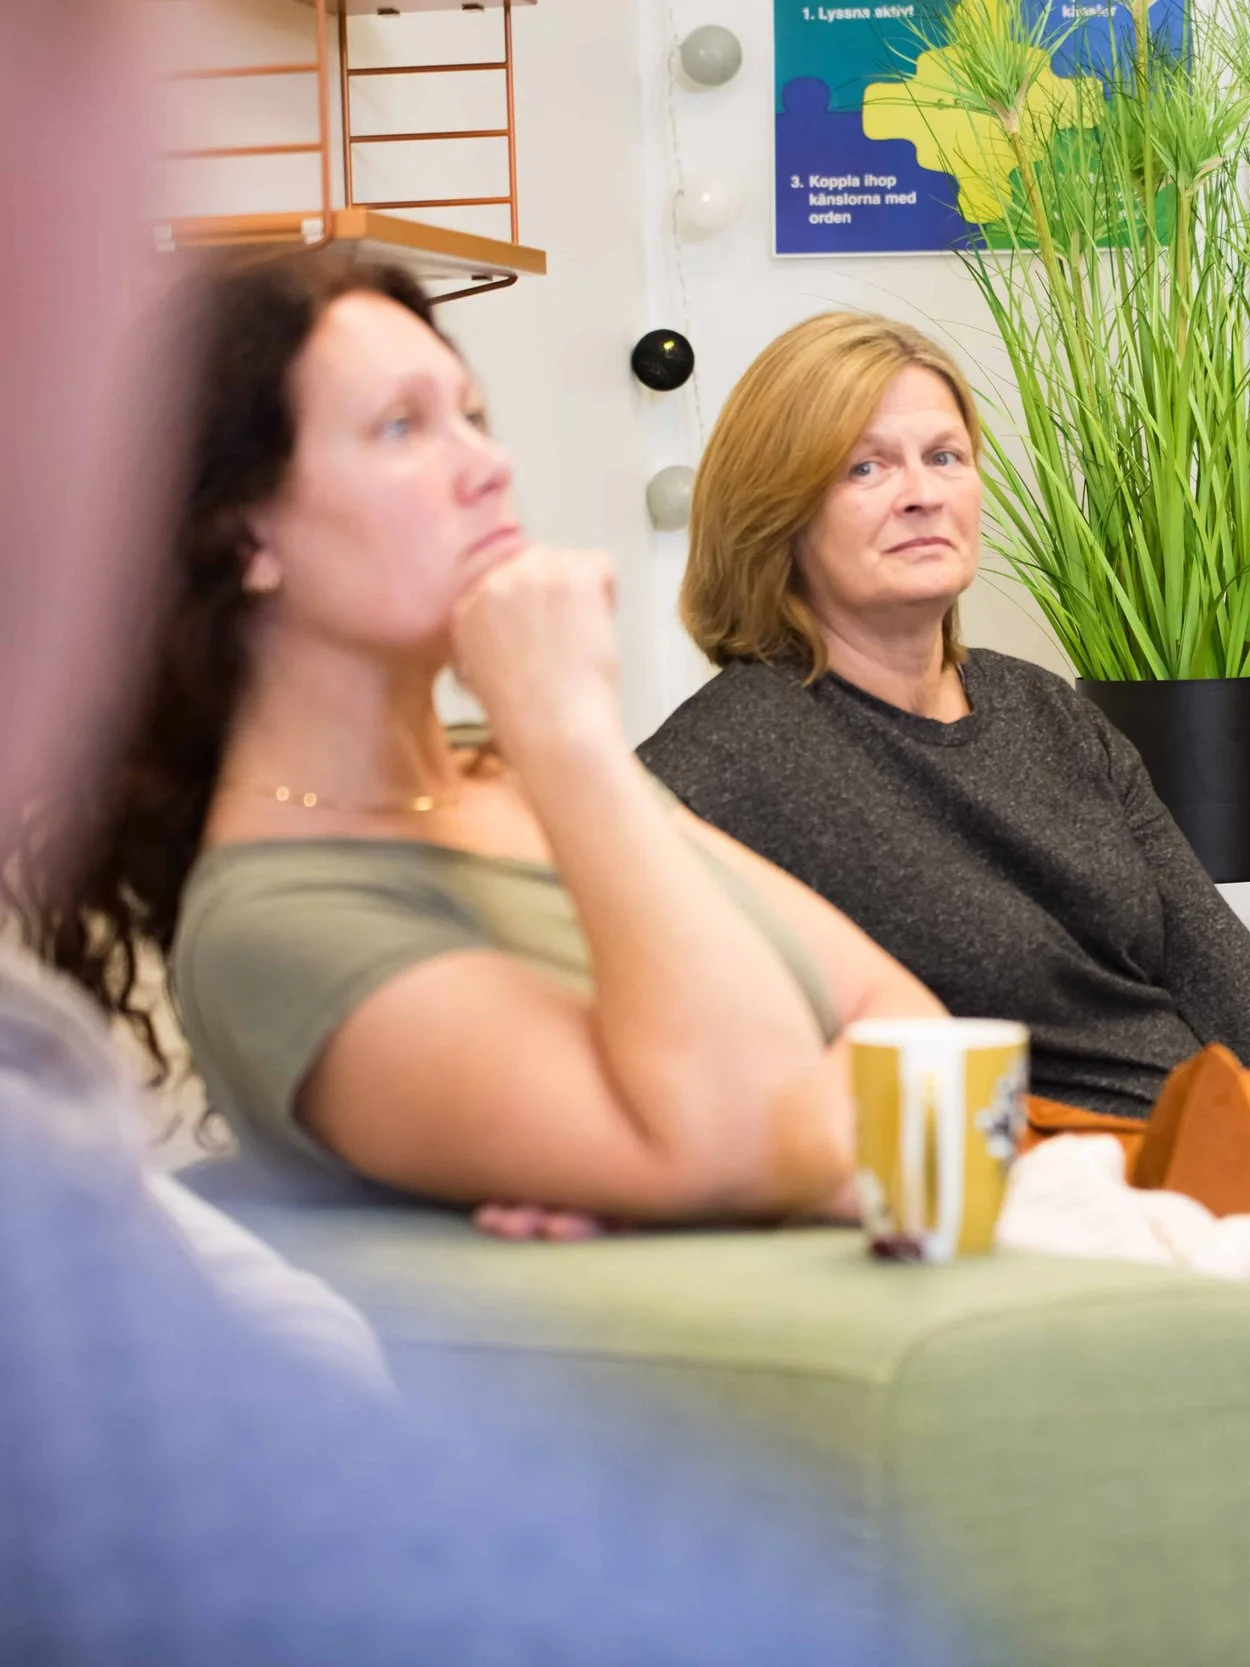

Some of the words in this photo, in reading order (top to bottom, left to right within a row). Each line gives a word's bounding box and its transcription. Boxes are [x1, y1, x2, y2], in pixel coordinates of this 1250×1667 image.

[802, 6, 815, 20] 1.
[818, 6, 870, 23] Lyssna
[790, 175, 804, 189] 3.
[809, 174, 861, 191] Koppla
[864, 173, 897, 190] ihop
[809, 192, 881, 206] känslorna
[885, 190, 917, 205] med
[809, 210, 852, 224] orden
